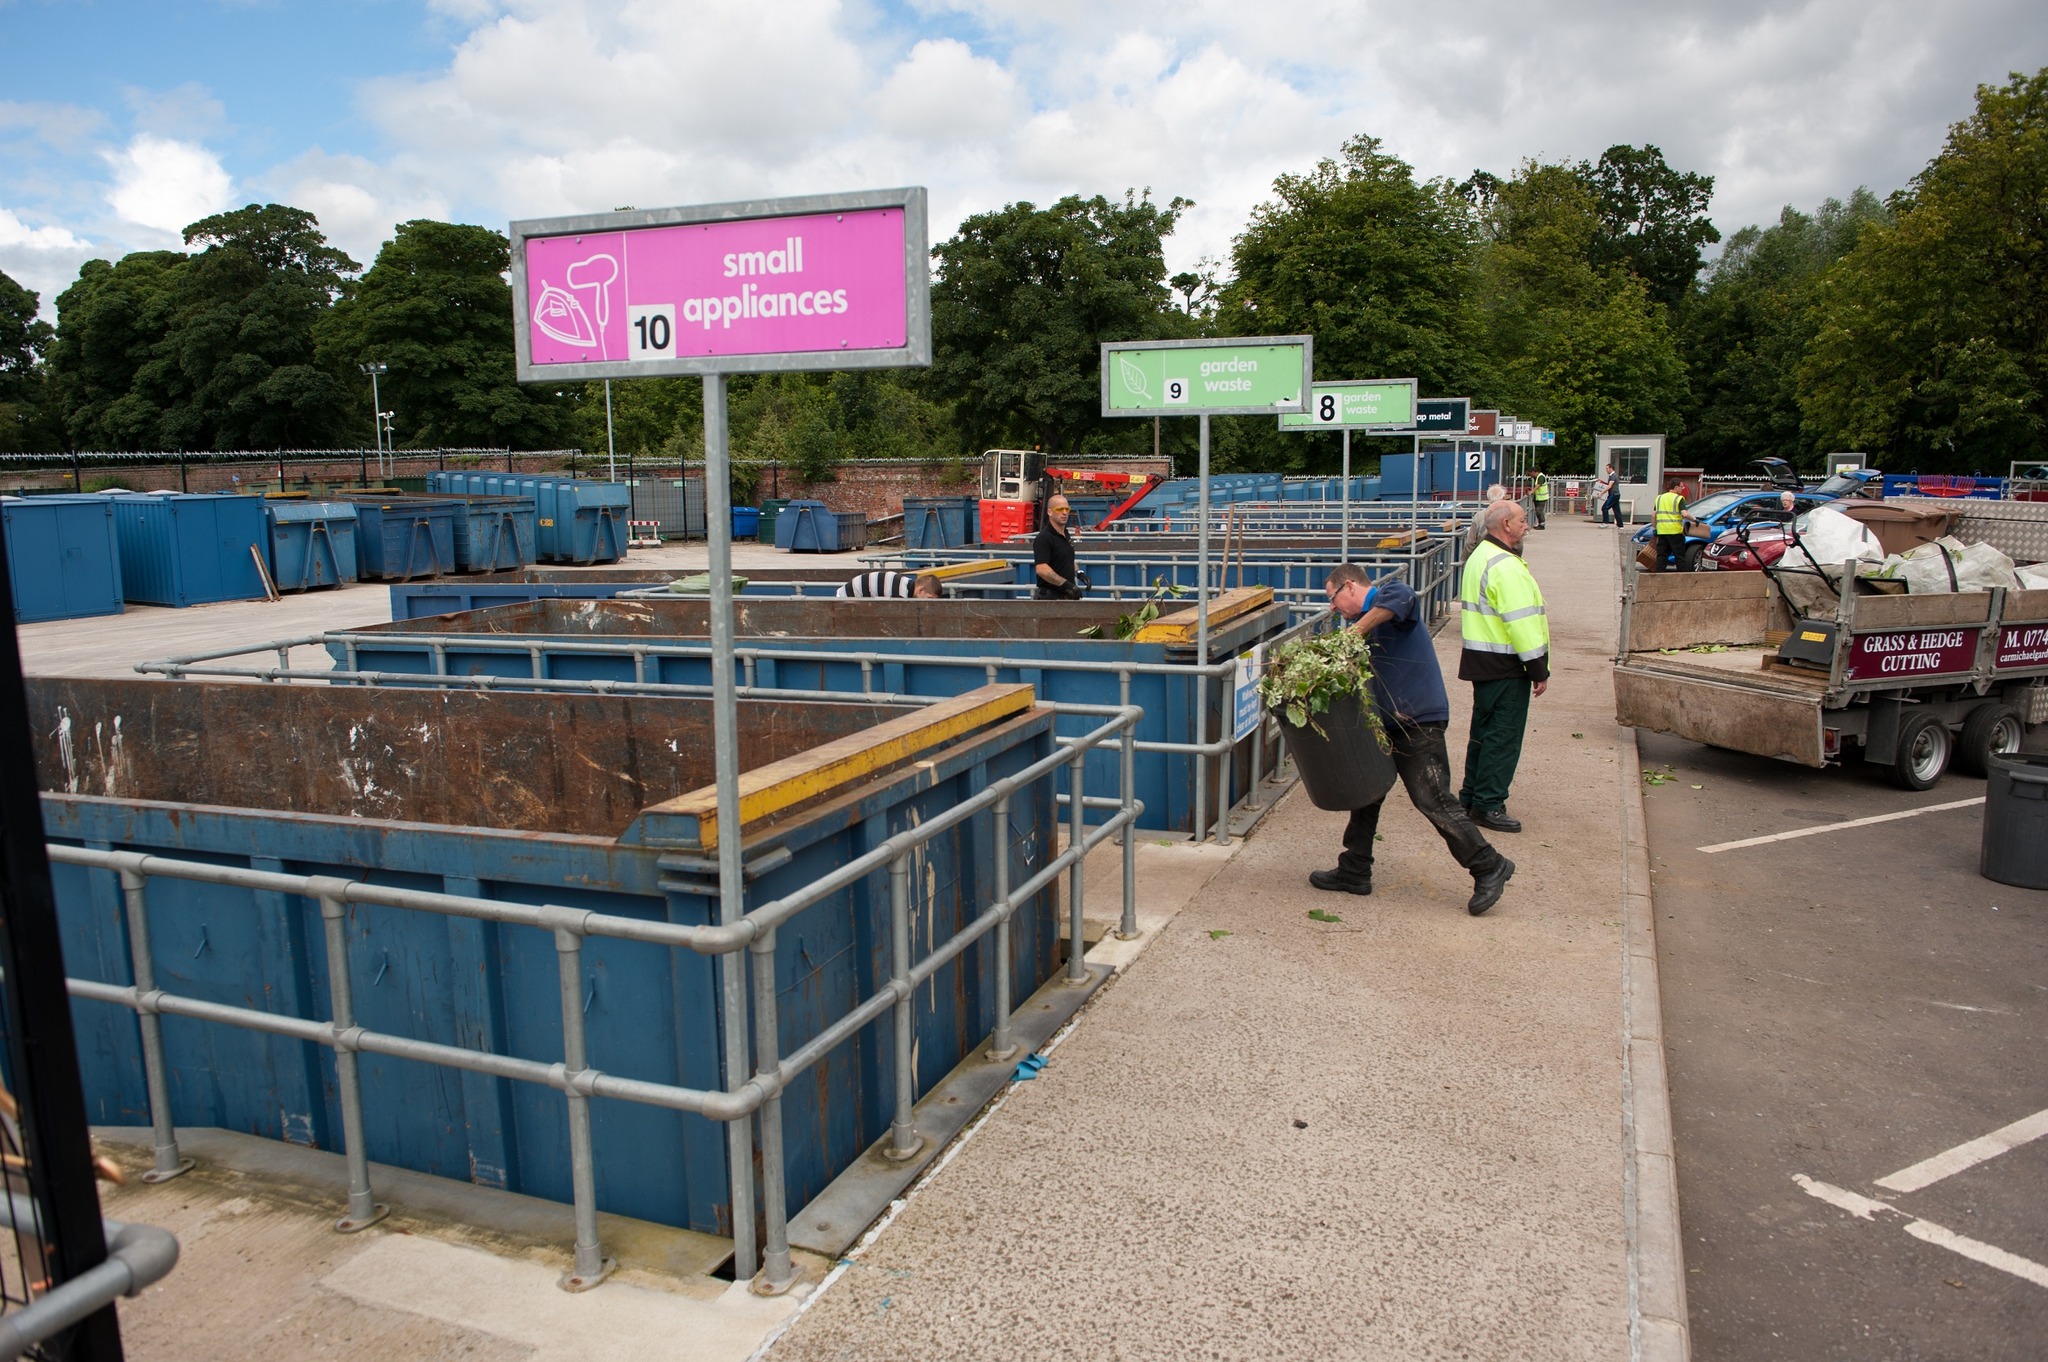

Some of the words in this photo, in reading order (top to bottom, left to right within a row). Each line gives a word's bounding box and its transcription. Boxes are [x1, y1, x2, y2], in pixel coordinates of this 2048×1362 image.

[723, 236, 803, 278] small
[683, 284, 849, 330] appliances
[634, 314, 671, 350] 10
[1200, 356, 1258, 377] garden
[1169, 382, 1182, 400] 9
[1204, 376, 1252, 393] waste
[1343, 391, 1381, 404] garden
[1319, 394, 1336, 422] 8
[1346, 403, 1378, 415] waste
[1429, 412, 1451, 420] metal
[1469, 453, 1481, 470] 2
[1864, 635, 1905, 653] GRASS
[1907, 634, 1918, 650] &
[1920, 631, 1963, 649] HEDGE
[2004, 631, 2020, 648] M.
[1882, 653, 1940, 671] CUTTING
